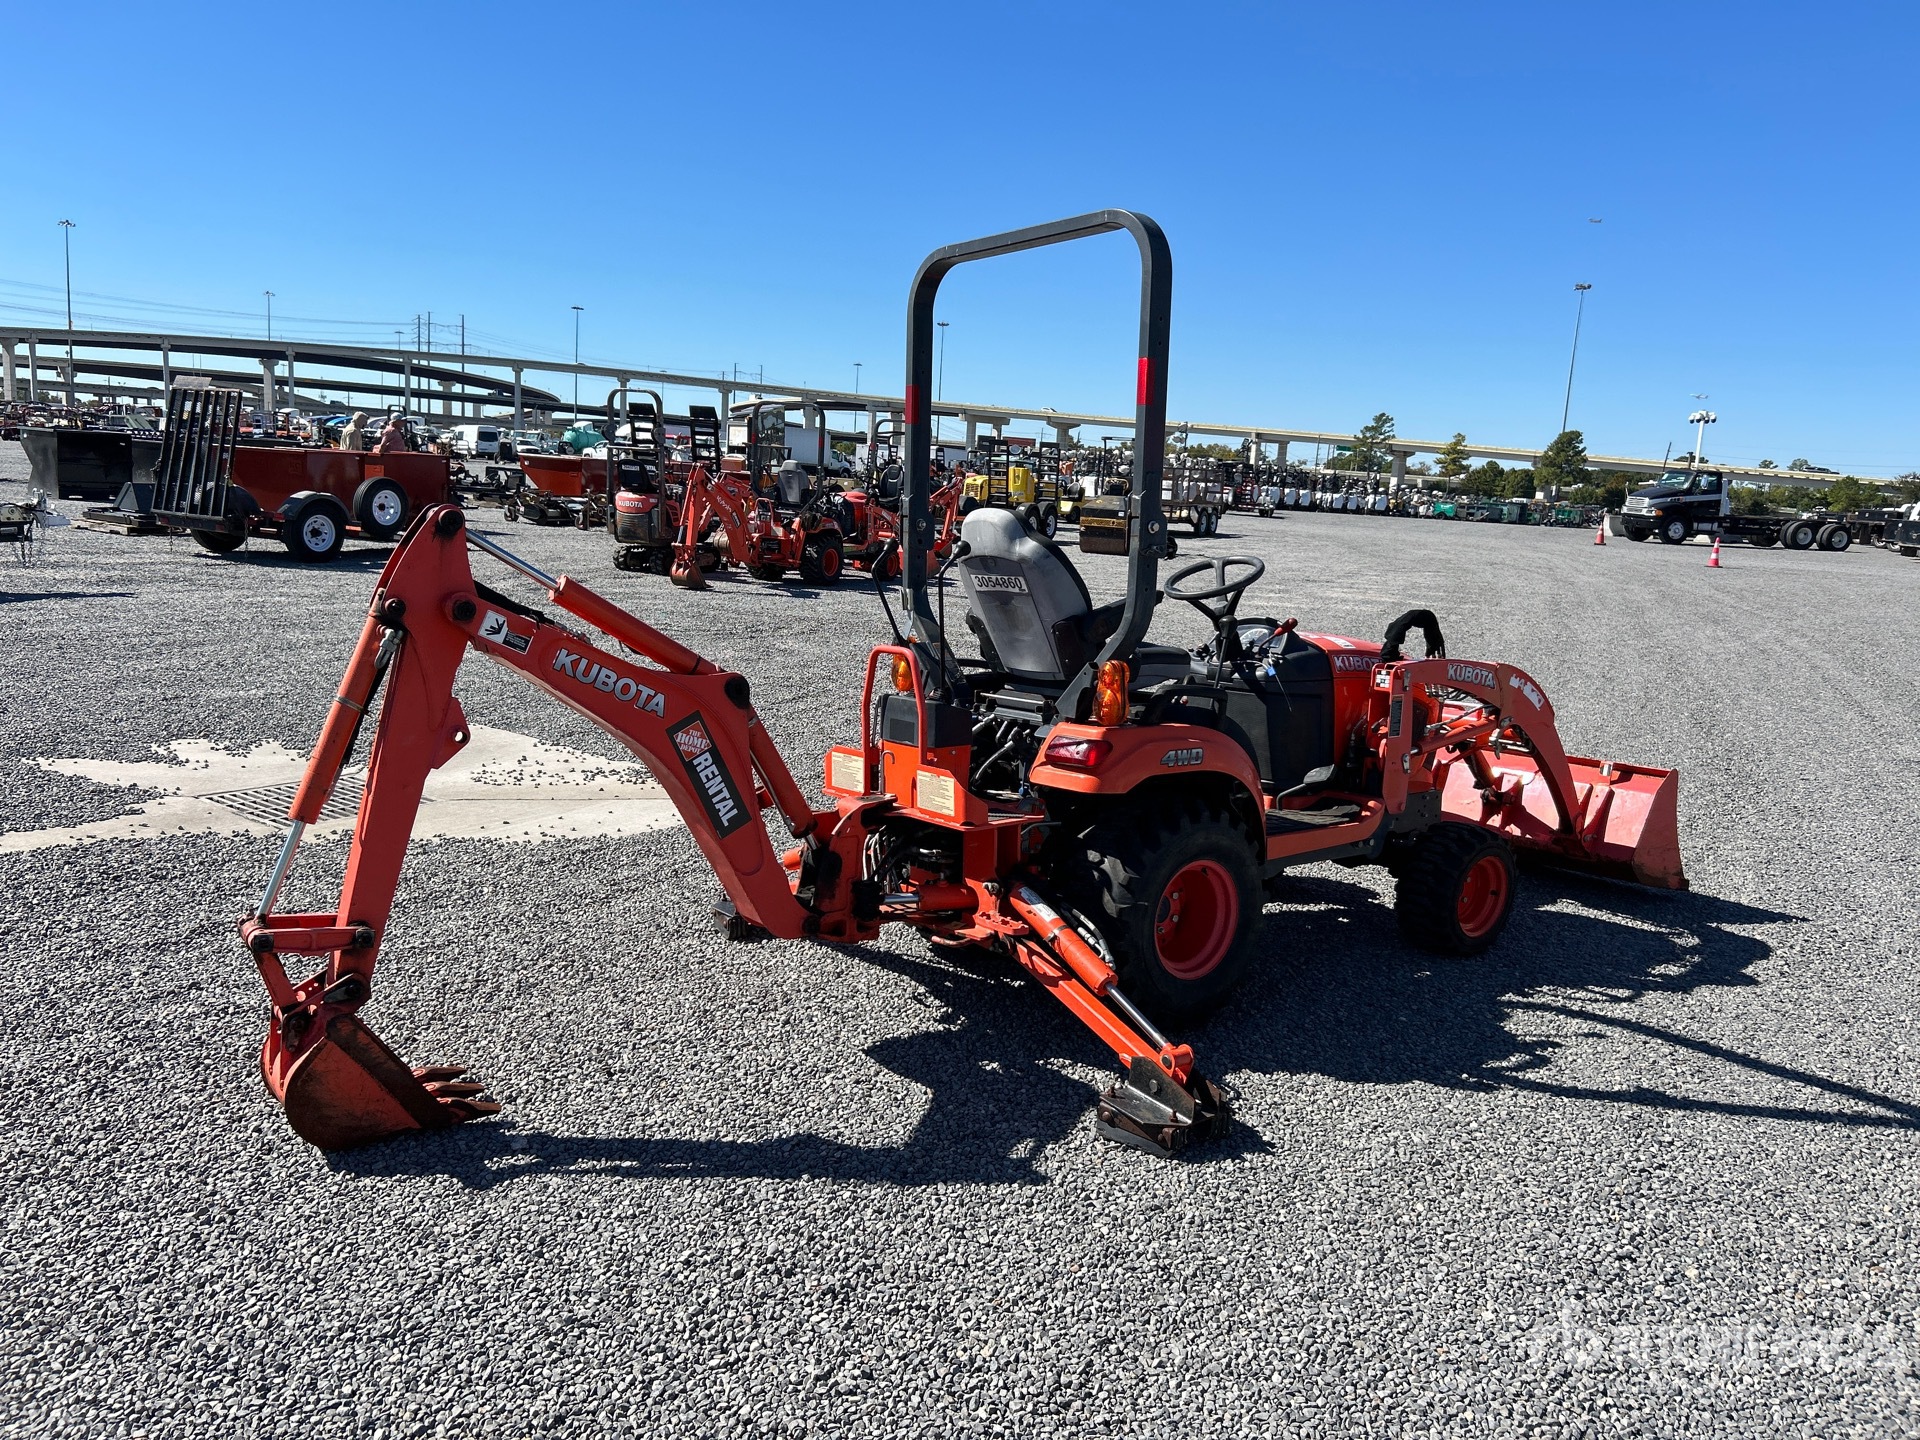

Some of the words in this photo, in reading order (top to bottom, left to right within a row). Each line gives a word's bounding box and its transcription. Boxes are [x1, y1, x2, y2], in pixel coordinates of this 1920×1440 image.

[975, 576, 1023, 589] 3054860
[1333, 656, 1382, 671] KUBO
[553, 648, 665, 718] KUBOTA
[1447, 664, 1496, 689] KUBOTA
[676, 732, 708, 750] HOME
[689, 729, 702, 738] THE
[680, 743, 701, 755] DEPOT
[1160, 748, 1203, 767] 4WD
[692, 751, 738, 827] RENTAL
